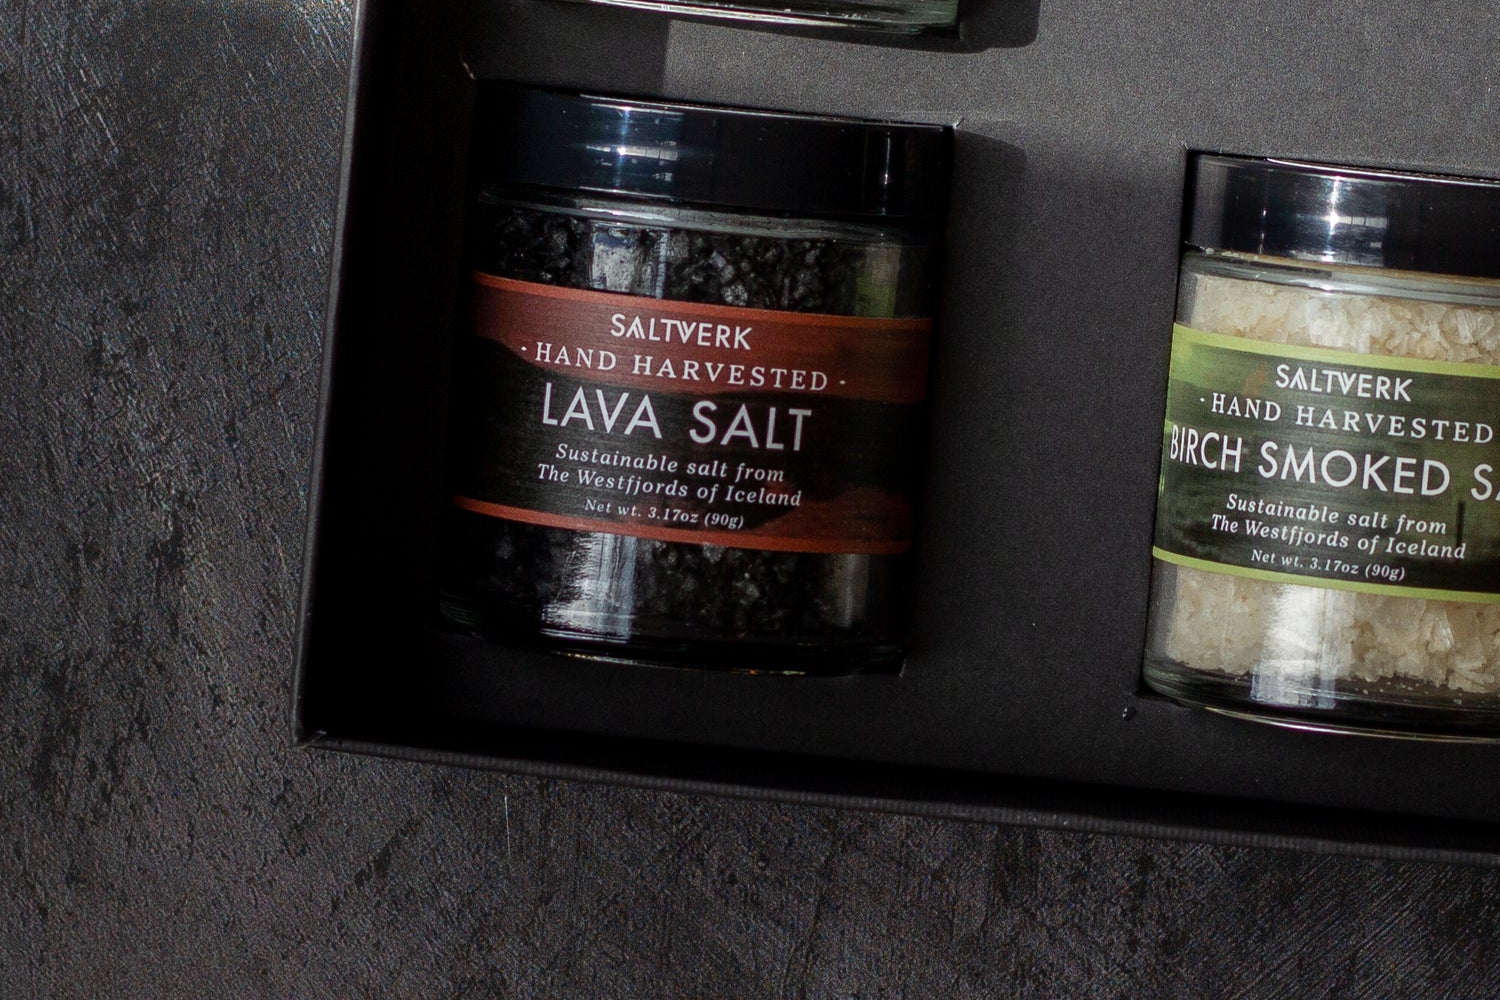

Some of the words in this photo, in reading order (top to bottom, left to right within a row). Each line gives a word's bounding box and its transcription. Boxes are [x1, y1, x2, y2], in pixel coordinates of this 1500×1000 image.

[611, 313, 752, 350] SALTVERK
[535, 342, 617, 370] HAND
[633, 356, 828, 391] HARVESTED
[1275, 364, 1413, 402] SALTVERK
[542, 383, 662, 439] LAVA
[688, 400, 811, 451] SALT
[1212, 393, 1281, 421] HAND
[1296, 406, 1494, 444] HARVESTED
[556, 444, 678, 473] Sustainable
[686, 459, 727, 477] salt
[735, 463, 784, 483] from
[1170, 425, 1242, 473] BIRCH
[1258, 441, 1450, 497] SMOKED
[538, 464, 569, 483] The
[578, 469, 688, 498] Westfjords
[697, 485, 719, 504] of
[726, 485, 801, 507] Iceland
[585, 499, 612, 514] Net
[618, 503, 641, 518] wt.
[648, 507, 699, 523] 3.17oz
[704, 512, 744, 530] (90g)
[1227, 493, 1339, 523] Sustainable
[1347, 510, 1388, 529] salt
[1396, 514, 1446, 535] from
[1212, 514, 1238, 533] The
[1245, 520, 1349, 549] Westfjords
[1357, 534, 1379, 555] of
[1386, 536, 1466, 559] Iceland
[1252, 549, 1275, 564] Net
[1282, 553, 1303, 568] wt.
[1310, 556, 1358, 575] 3.17oz
[1365, 562, 1405, 581] (90g)
